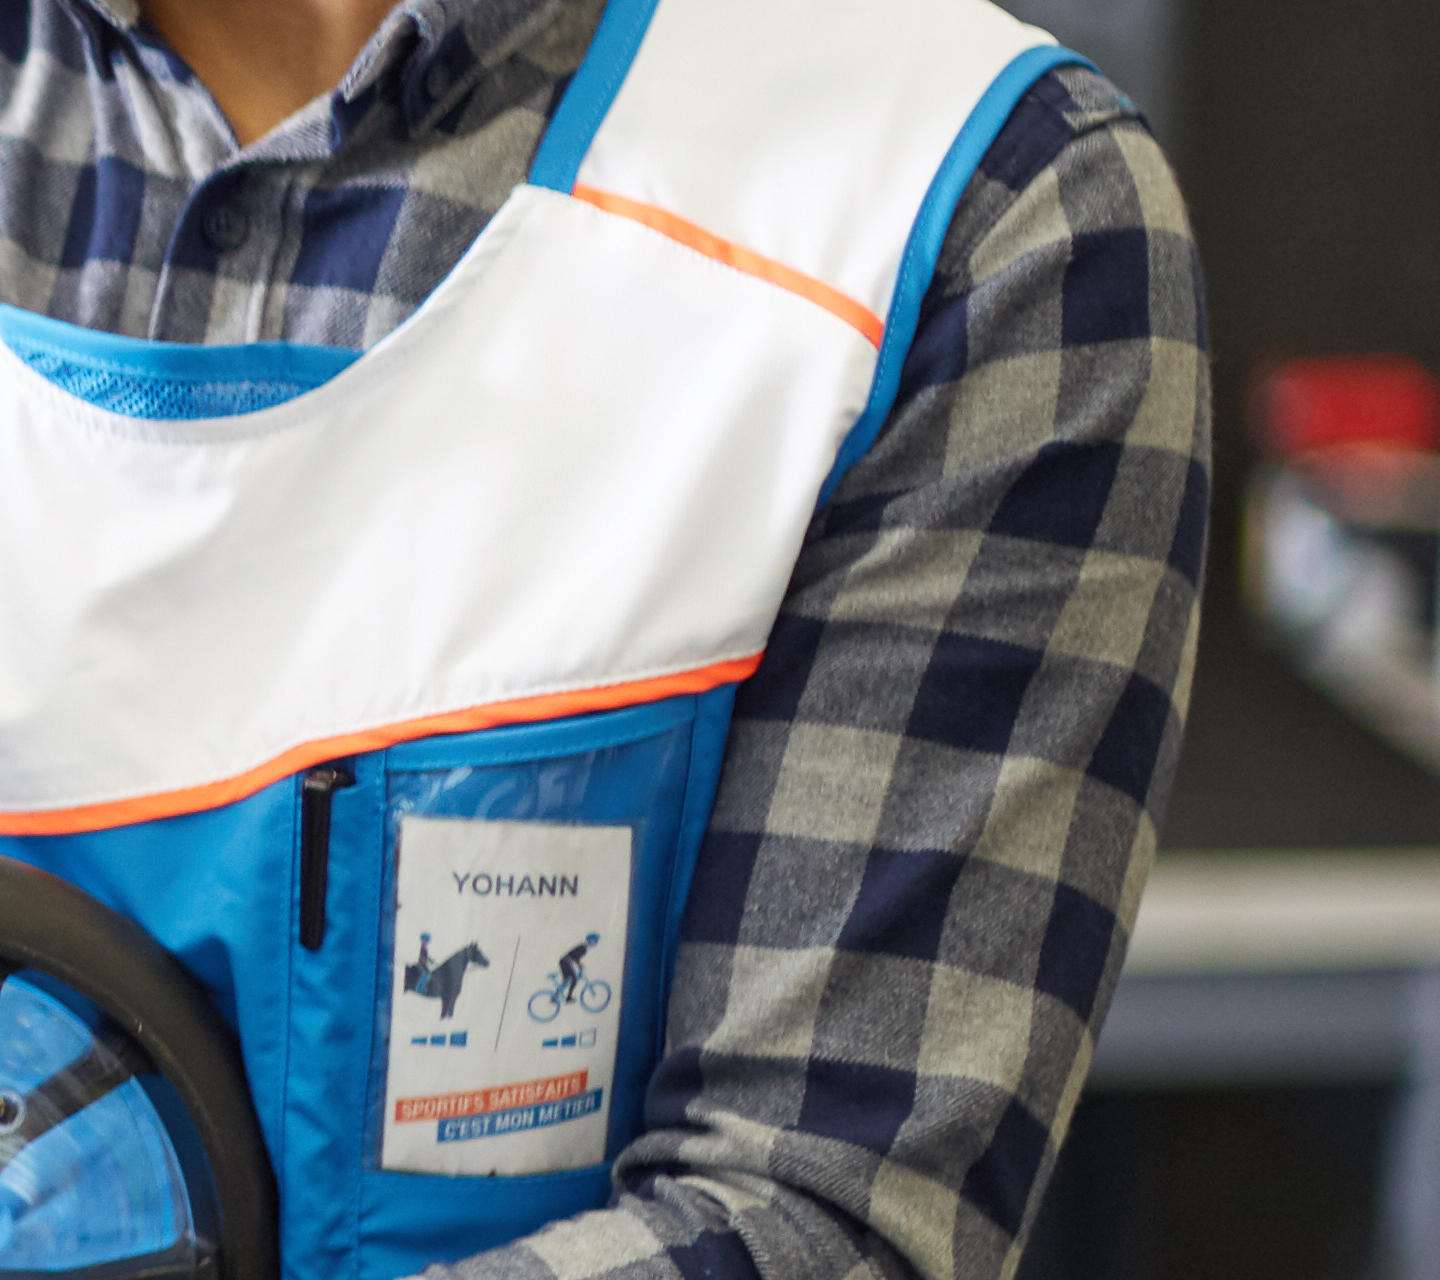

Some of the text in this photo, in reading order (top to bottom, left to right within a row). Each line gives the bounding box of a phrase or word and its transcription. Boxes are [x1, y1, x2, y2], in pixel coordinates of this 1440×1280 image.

[452, 870, 579, 897] YOHANN
[401, 1076, 581, 1118] SPORTIFS SATISFAITS
[495, 1107, 535, 1132] MON
